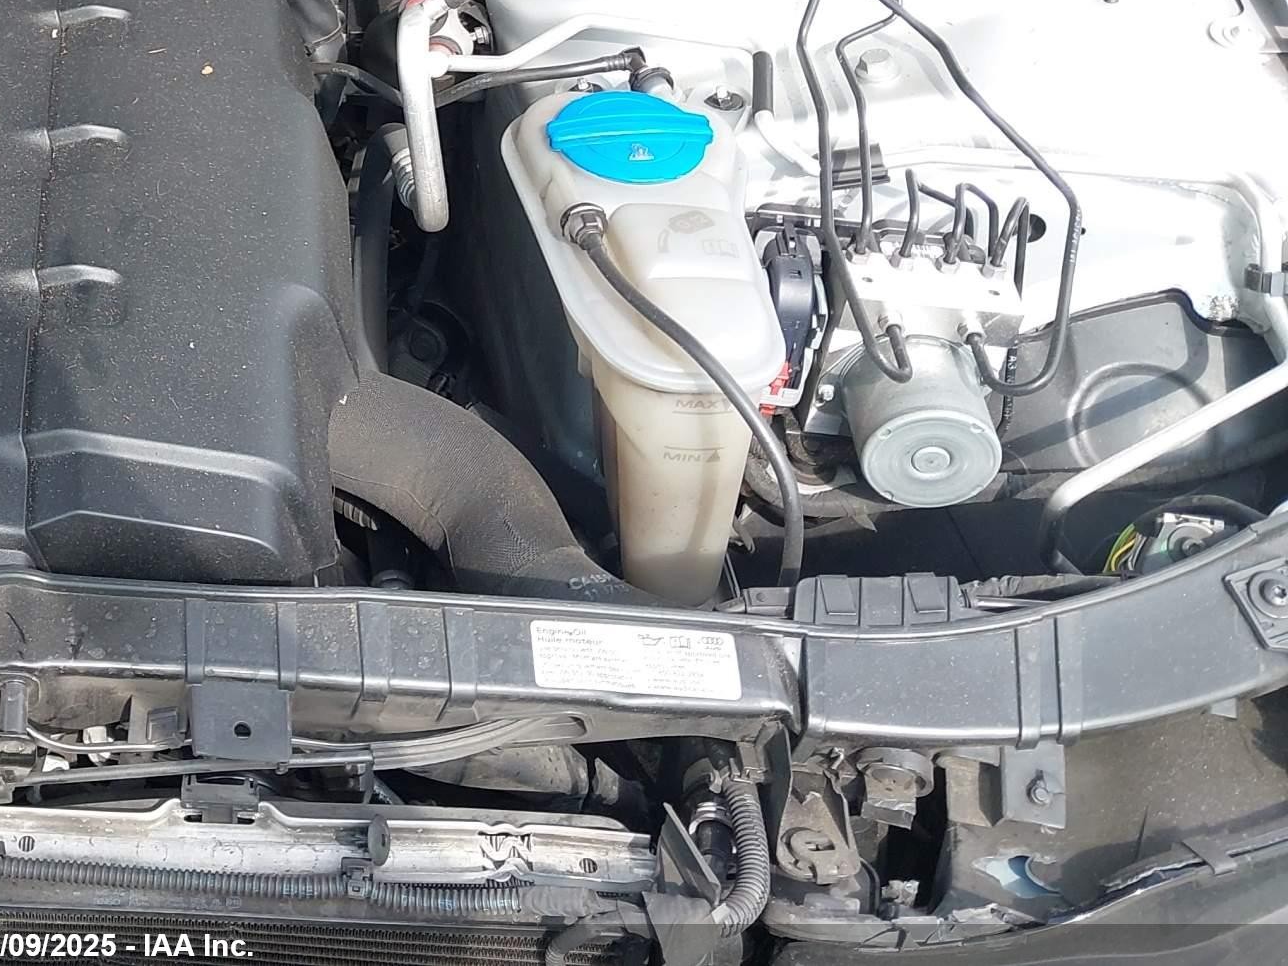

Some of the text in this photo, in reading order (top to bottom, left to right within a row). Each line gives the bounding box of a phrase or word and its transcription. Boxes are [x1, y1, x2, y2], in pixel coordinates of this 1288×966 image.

[675, 399, 719, 410] MAX
[663, 451, 701, 462] MIN
[572, 627, 587, 636] Oil
